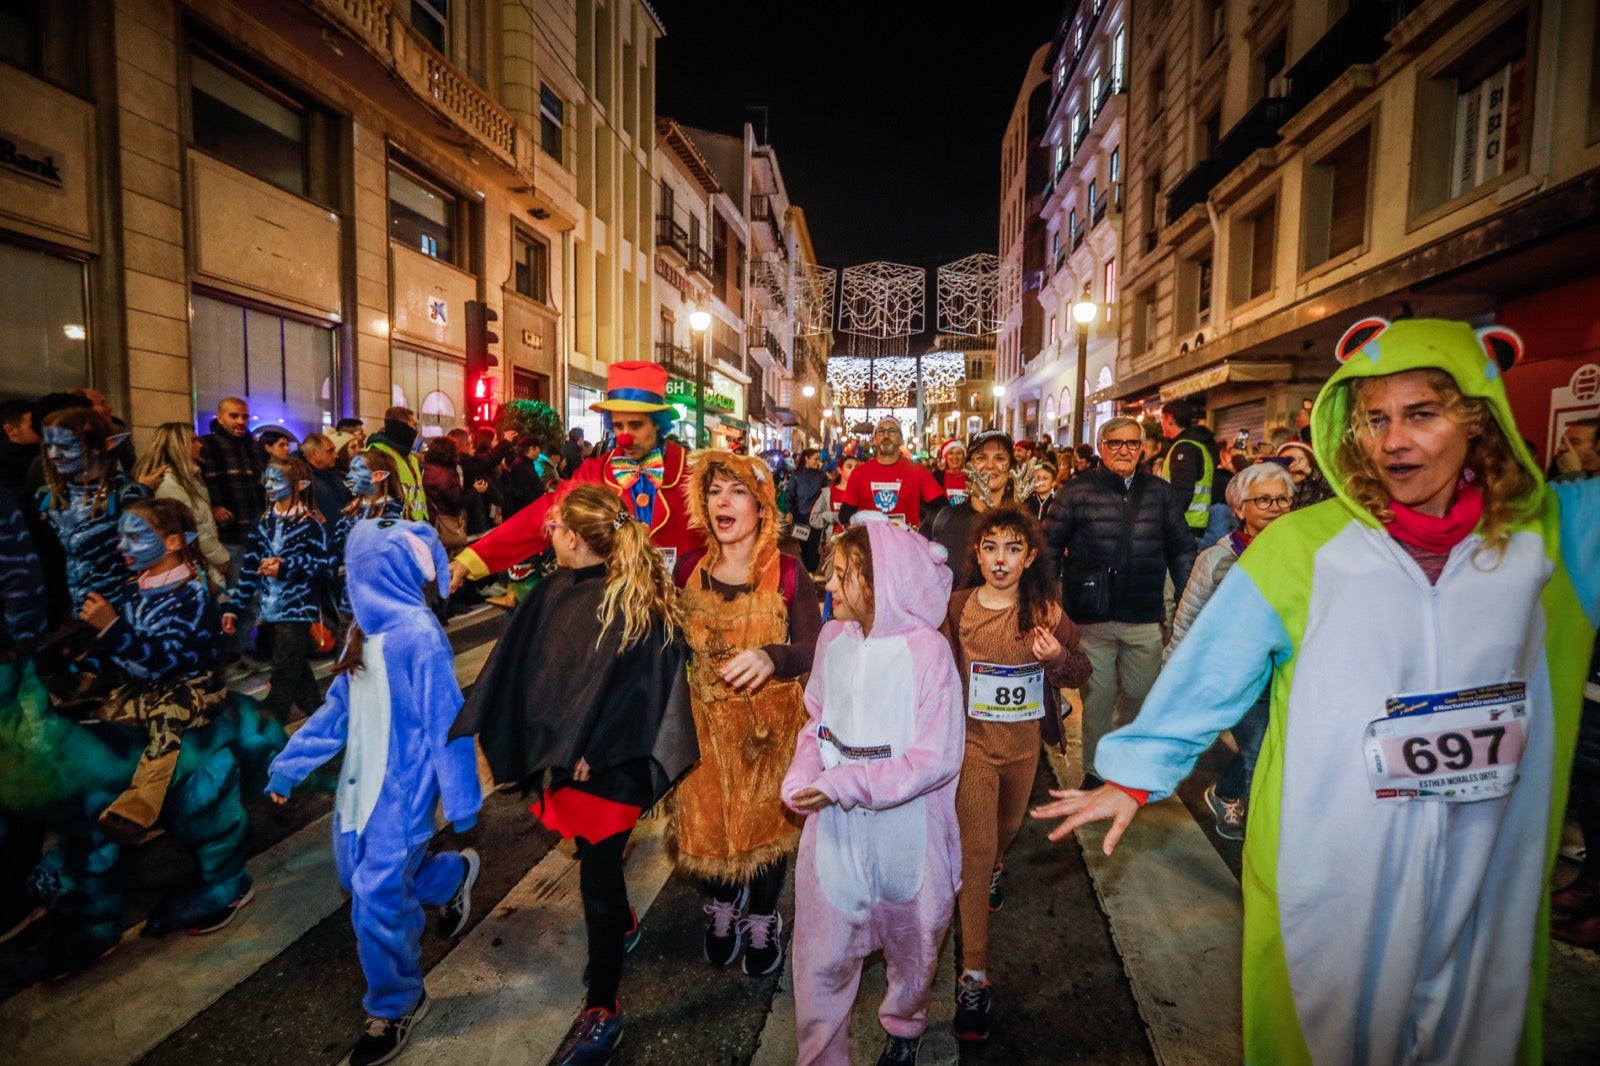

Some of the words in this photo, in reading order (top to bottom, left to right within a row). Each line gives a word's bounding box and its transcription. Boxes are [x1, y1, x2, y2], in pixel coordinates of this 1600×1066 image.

[995, 686, 1026, 705] 89
[1402, 726, 1506, 775] 697
[1418, 776, 1446, 788] ESTHER
[1446, 773, 1479, 786] MORALES
